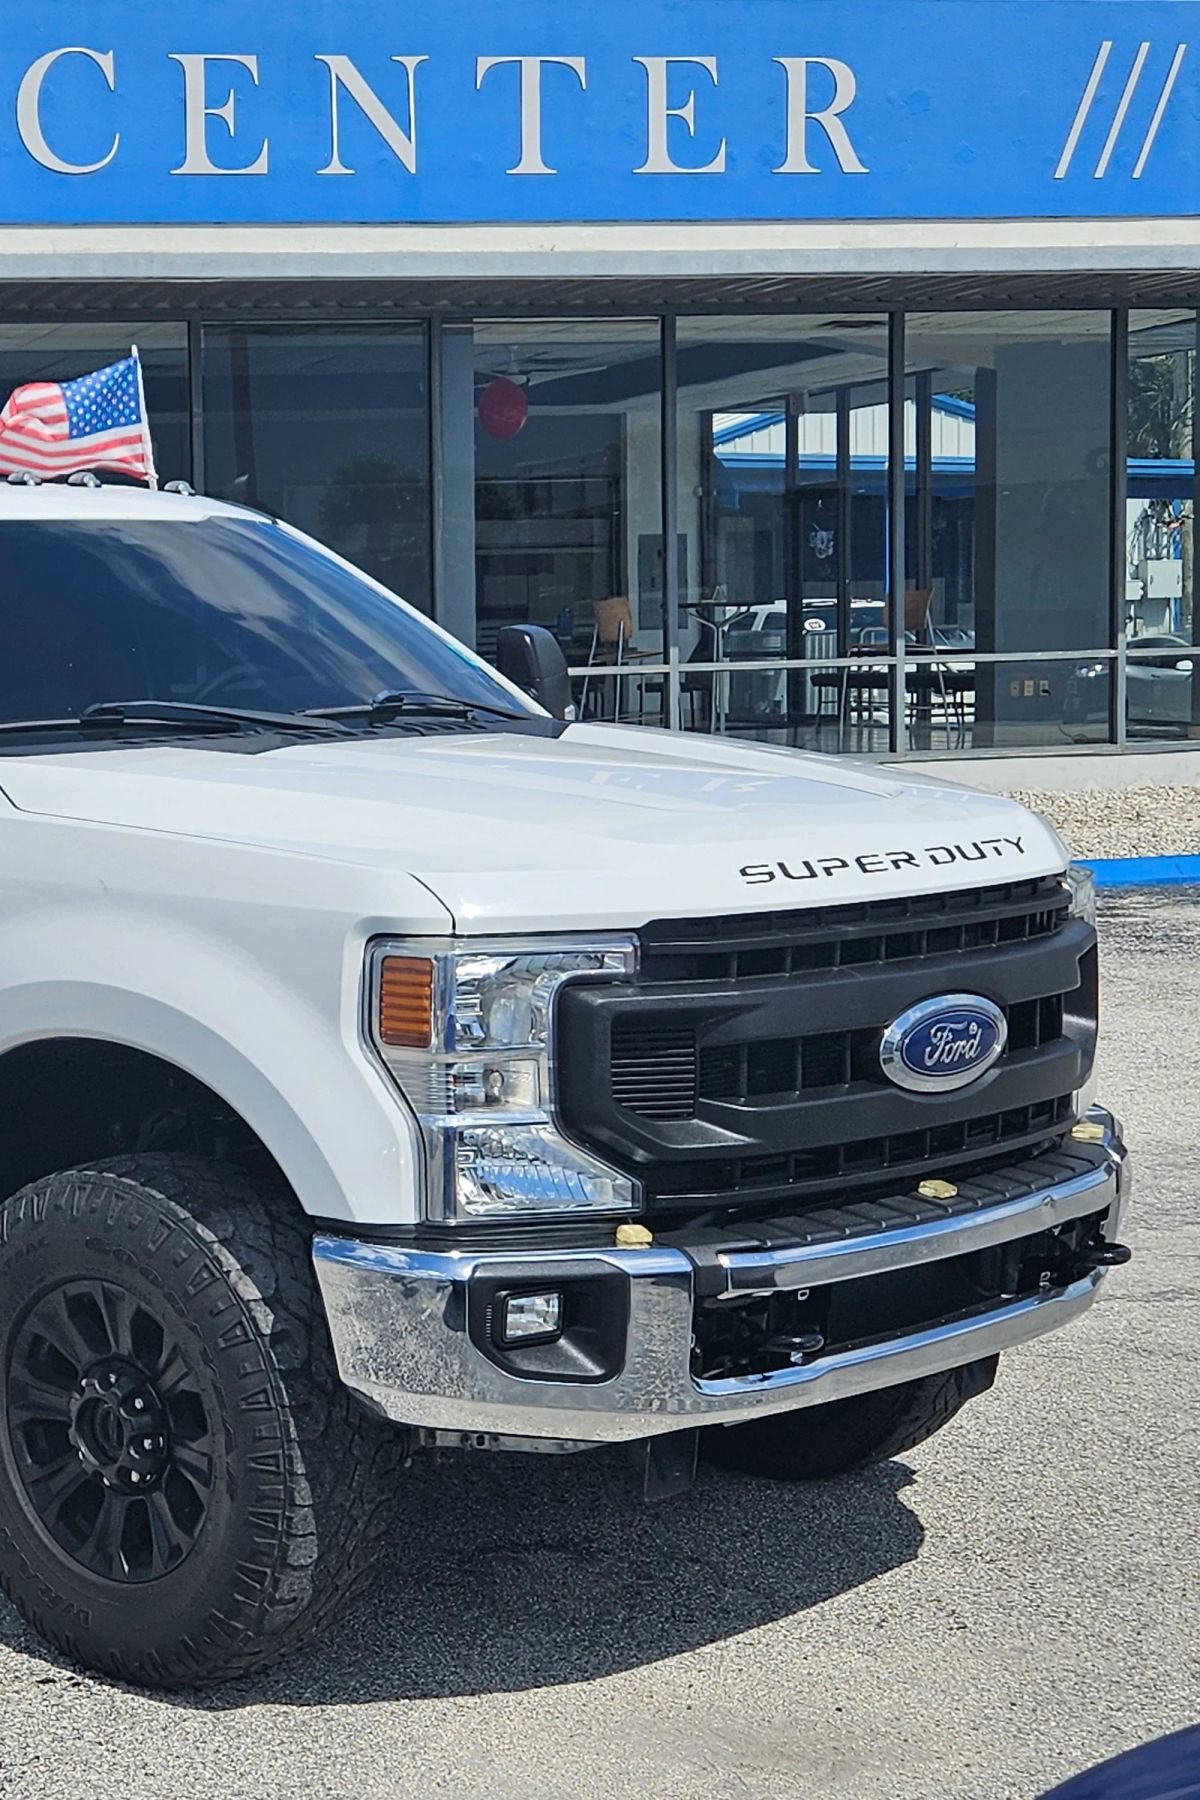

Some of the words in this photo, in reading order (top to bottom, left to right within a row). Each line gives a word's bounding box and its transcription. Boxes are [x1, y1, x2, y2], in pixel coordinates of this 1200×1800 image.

[16, 46, 870, 176] CENTER
[739, 850, 920, 885] SUPER
[924, 836, 1026, 866] DUTY
[924, 1021, 982, 1067] Ford
